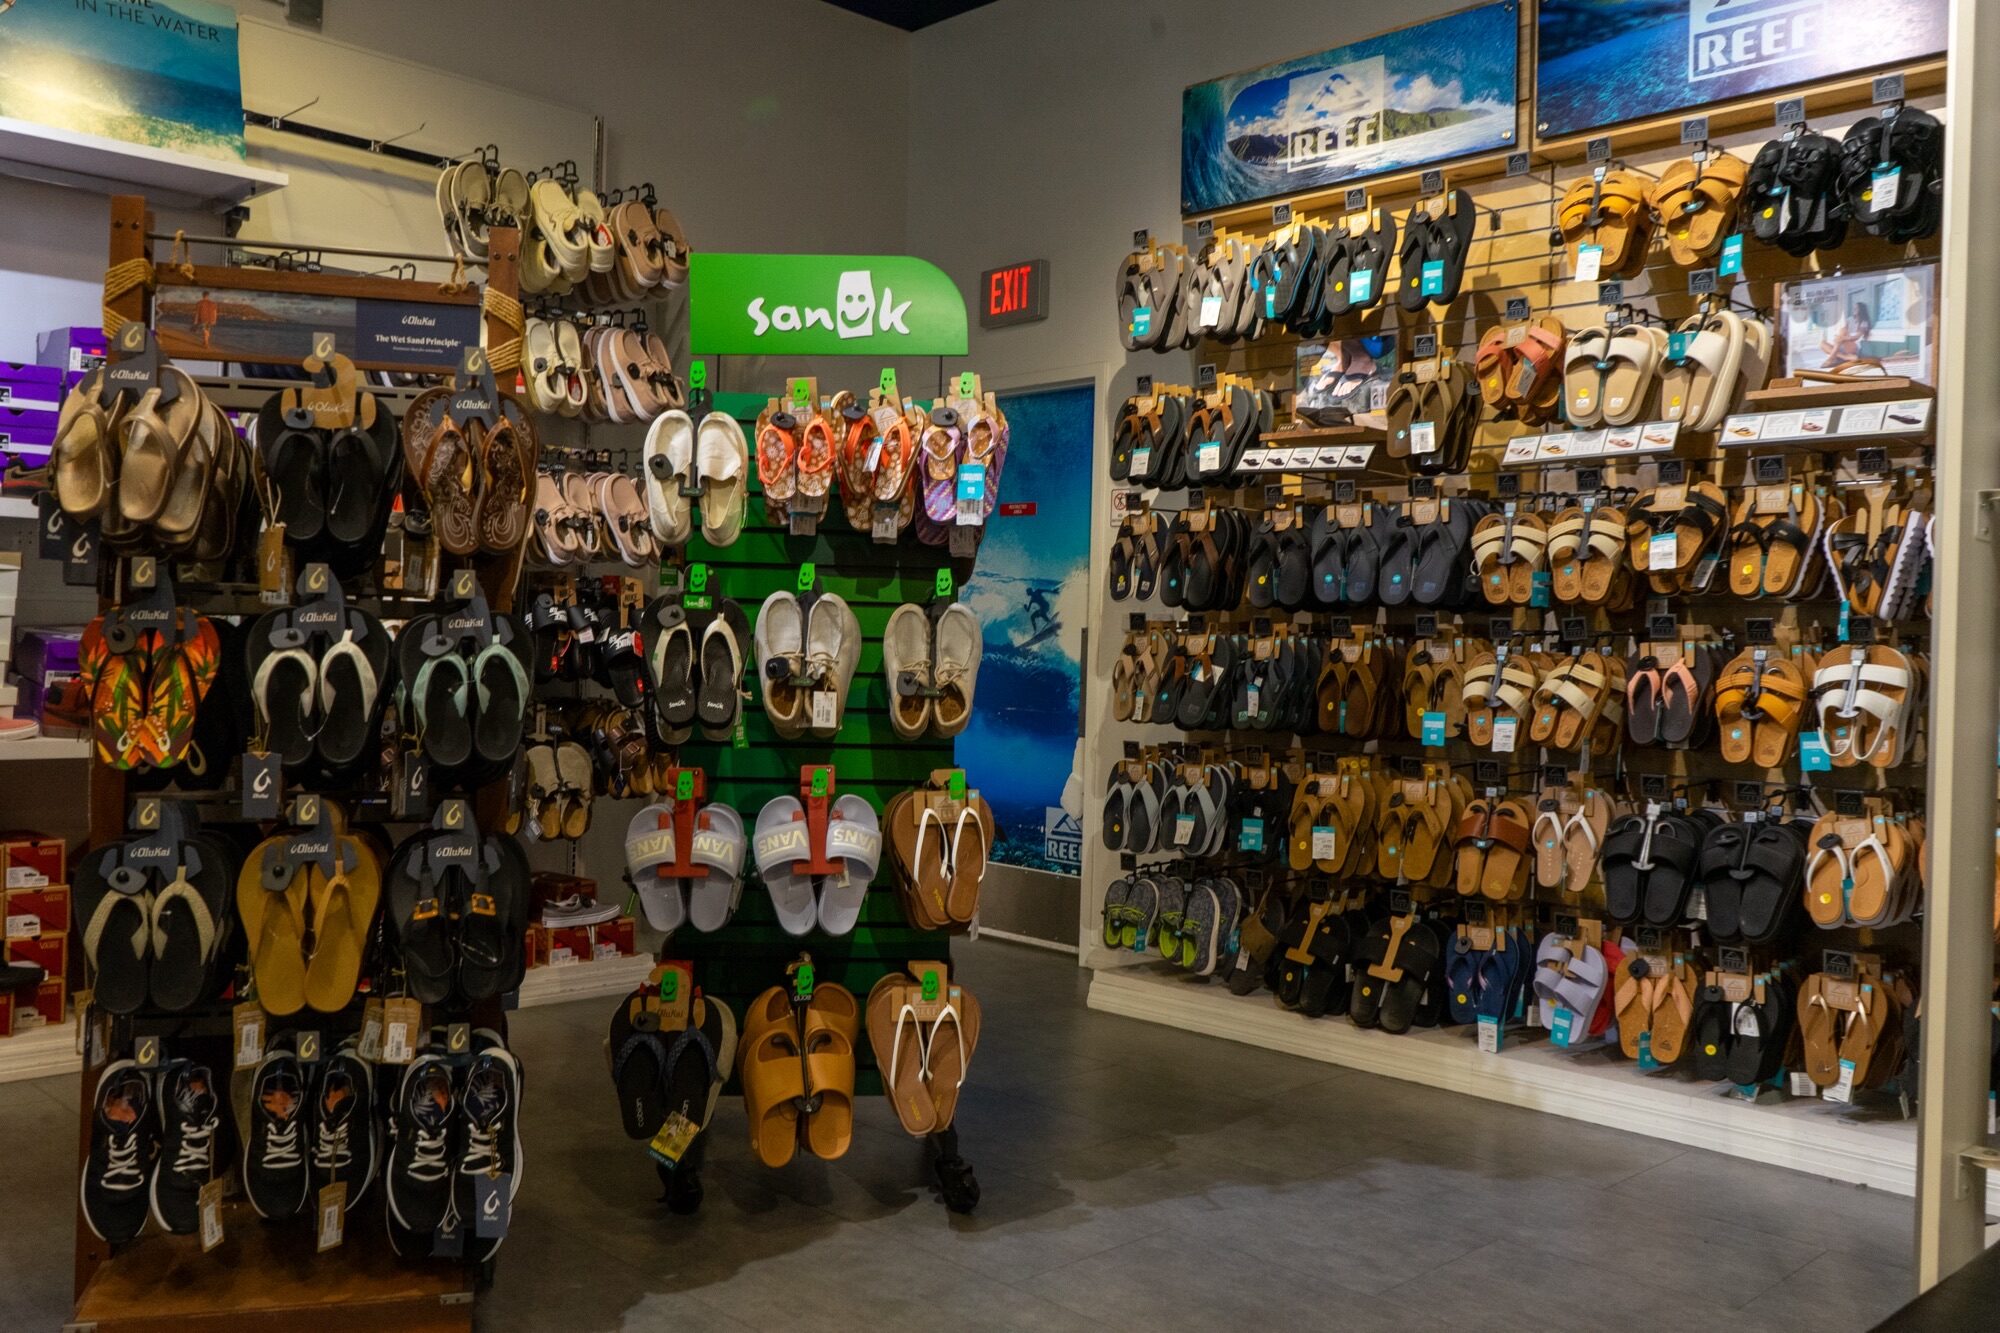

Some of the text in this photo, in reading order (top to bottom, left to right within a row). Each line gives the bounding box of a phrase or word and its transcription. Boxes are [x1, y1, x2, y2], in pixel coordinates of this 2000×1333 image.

[76, 0, 221, 42] IN THE WATER
[1698, 14, 1816, 71] REEF
[1294, 118, 1377, 162] REEF
[990, 265, 1031, 316] EXIT
[408, 315, 437, 327] OluKai
[374, 334, 390, 343] The
[391, 335, 406, 344] Wet
[406, 335, 425, 345] Sand
[118, 369, 149, 381] OluKai
[462, 399, 493, 410] OluKai
[137, 610, 169, 621] OluKai
[306, 611, 337, 622] OluKai
[455, 618, 484, 629] OluKai
[759, 830, 806, 859] VANS
[832, 828, 877, 858] VANS
[137, 847, 171, 857] OluKai
[297, 844, 328, 855] OluKai
[442, 846, 473, 857] OluKai
[630, 835, 675, 864] VANS
